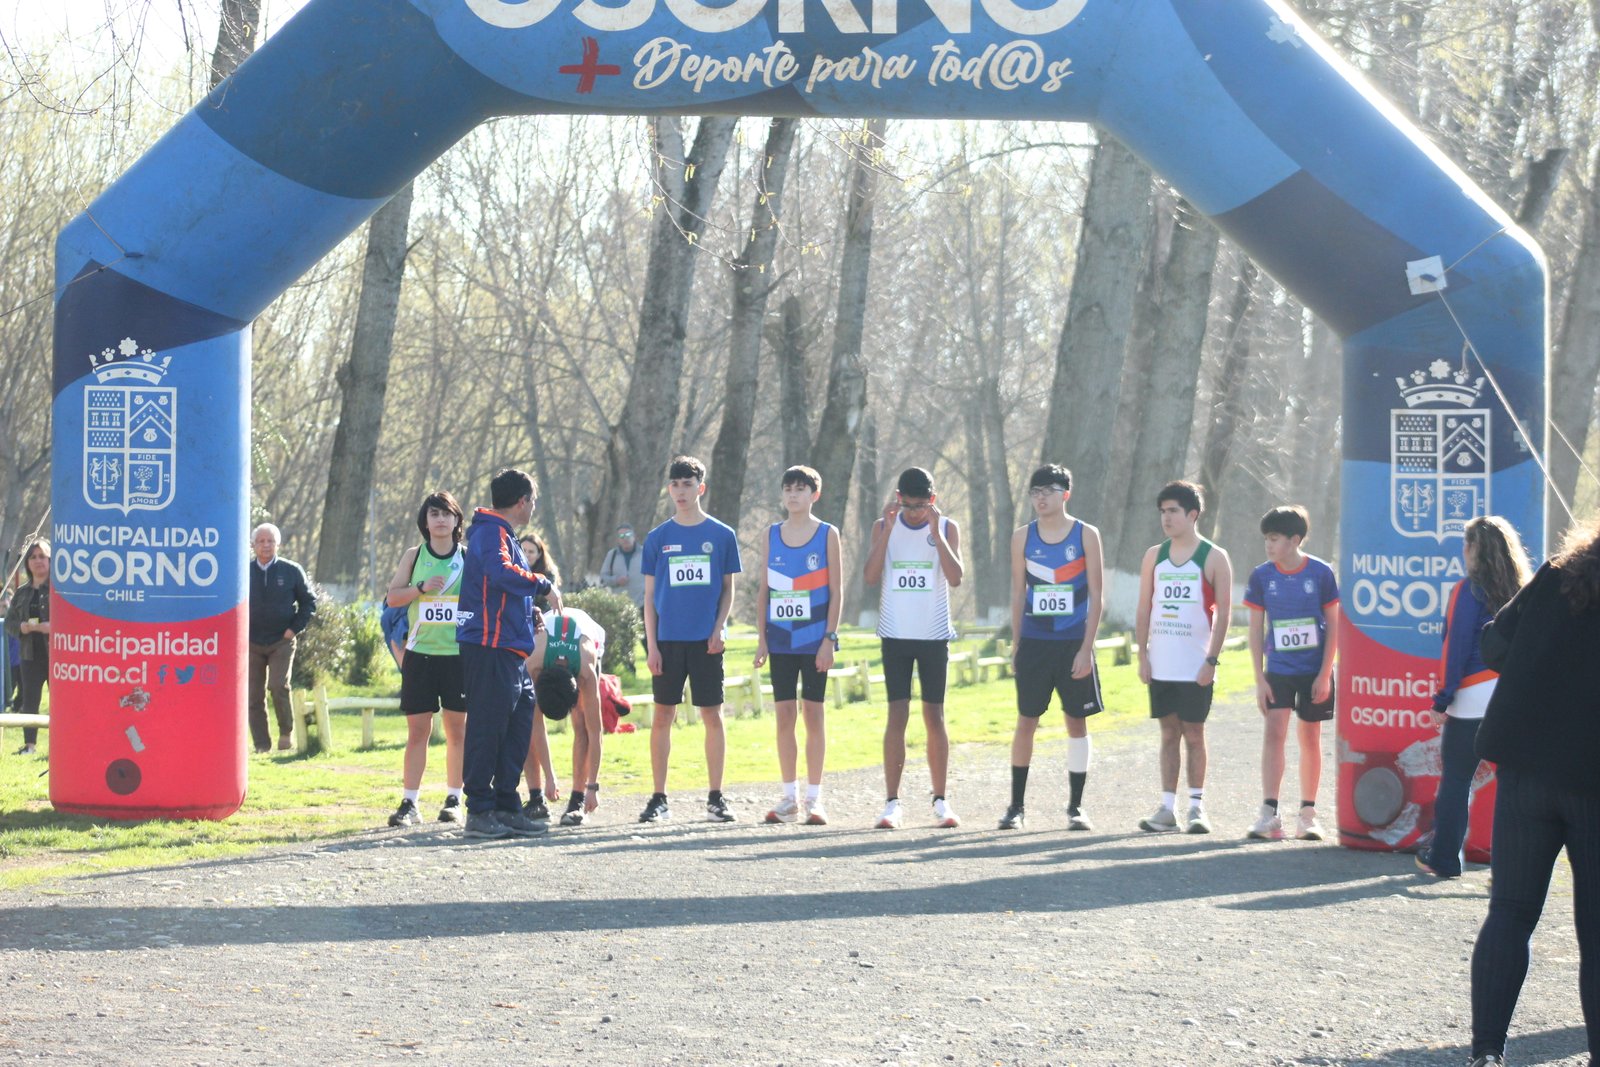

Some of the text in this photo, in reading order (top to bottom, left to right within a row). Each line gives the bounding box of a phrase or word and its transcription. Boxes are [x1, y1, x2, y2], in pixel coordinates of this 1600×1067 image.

[632, 36, 800, 93] Deporte
[805, 46, 917, 93] para
[54, 523, 219, 548] MUNICIPALIDAD
[54, 548, 218, 587] OSORNO
[1352, 554, 1465, 577] MUNICIPA
[676, 568, 704, 582] 004
[898, 576, 926, 588] 003
[105, 590, 145, 602] CHILE
[1164, 586, 1191, 599] 002
[1352, 579, 1456, 617] OSO
[776, 604, 804, 618] 006
[1039, 598, 1067, 611] 005
[425, 608, 453, 621] 050
[53, 629, 218, 660] municipalidad
[1281, 632, 1309, 647] 007
[53, 661, 147, 684] osorno.cl
[1351, 706, 1434, 728] osorno
